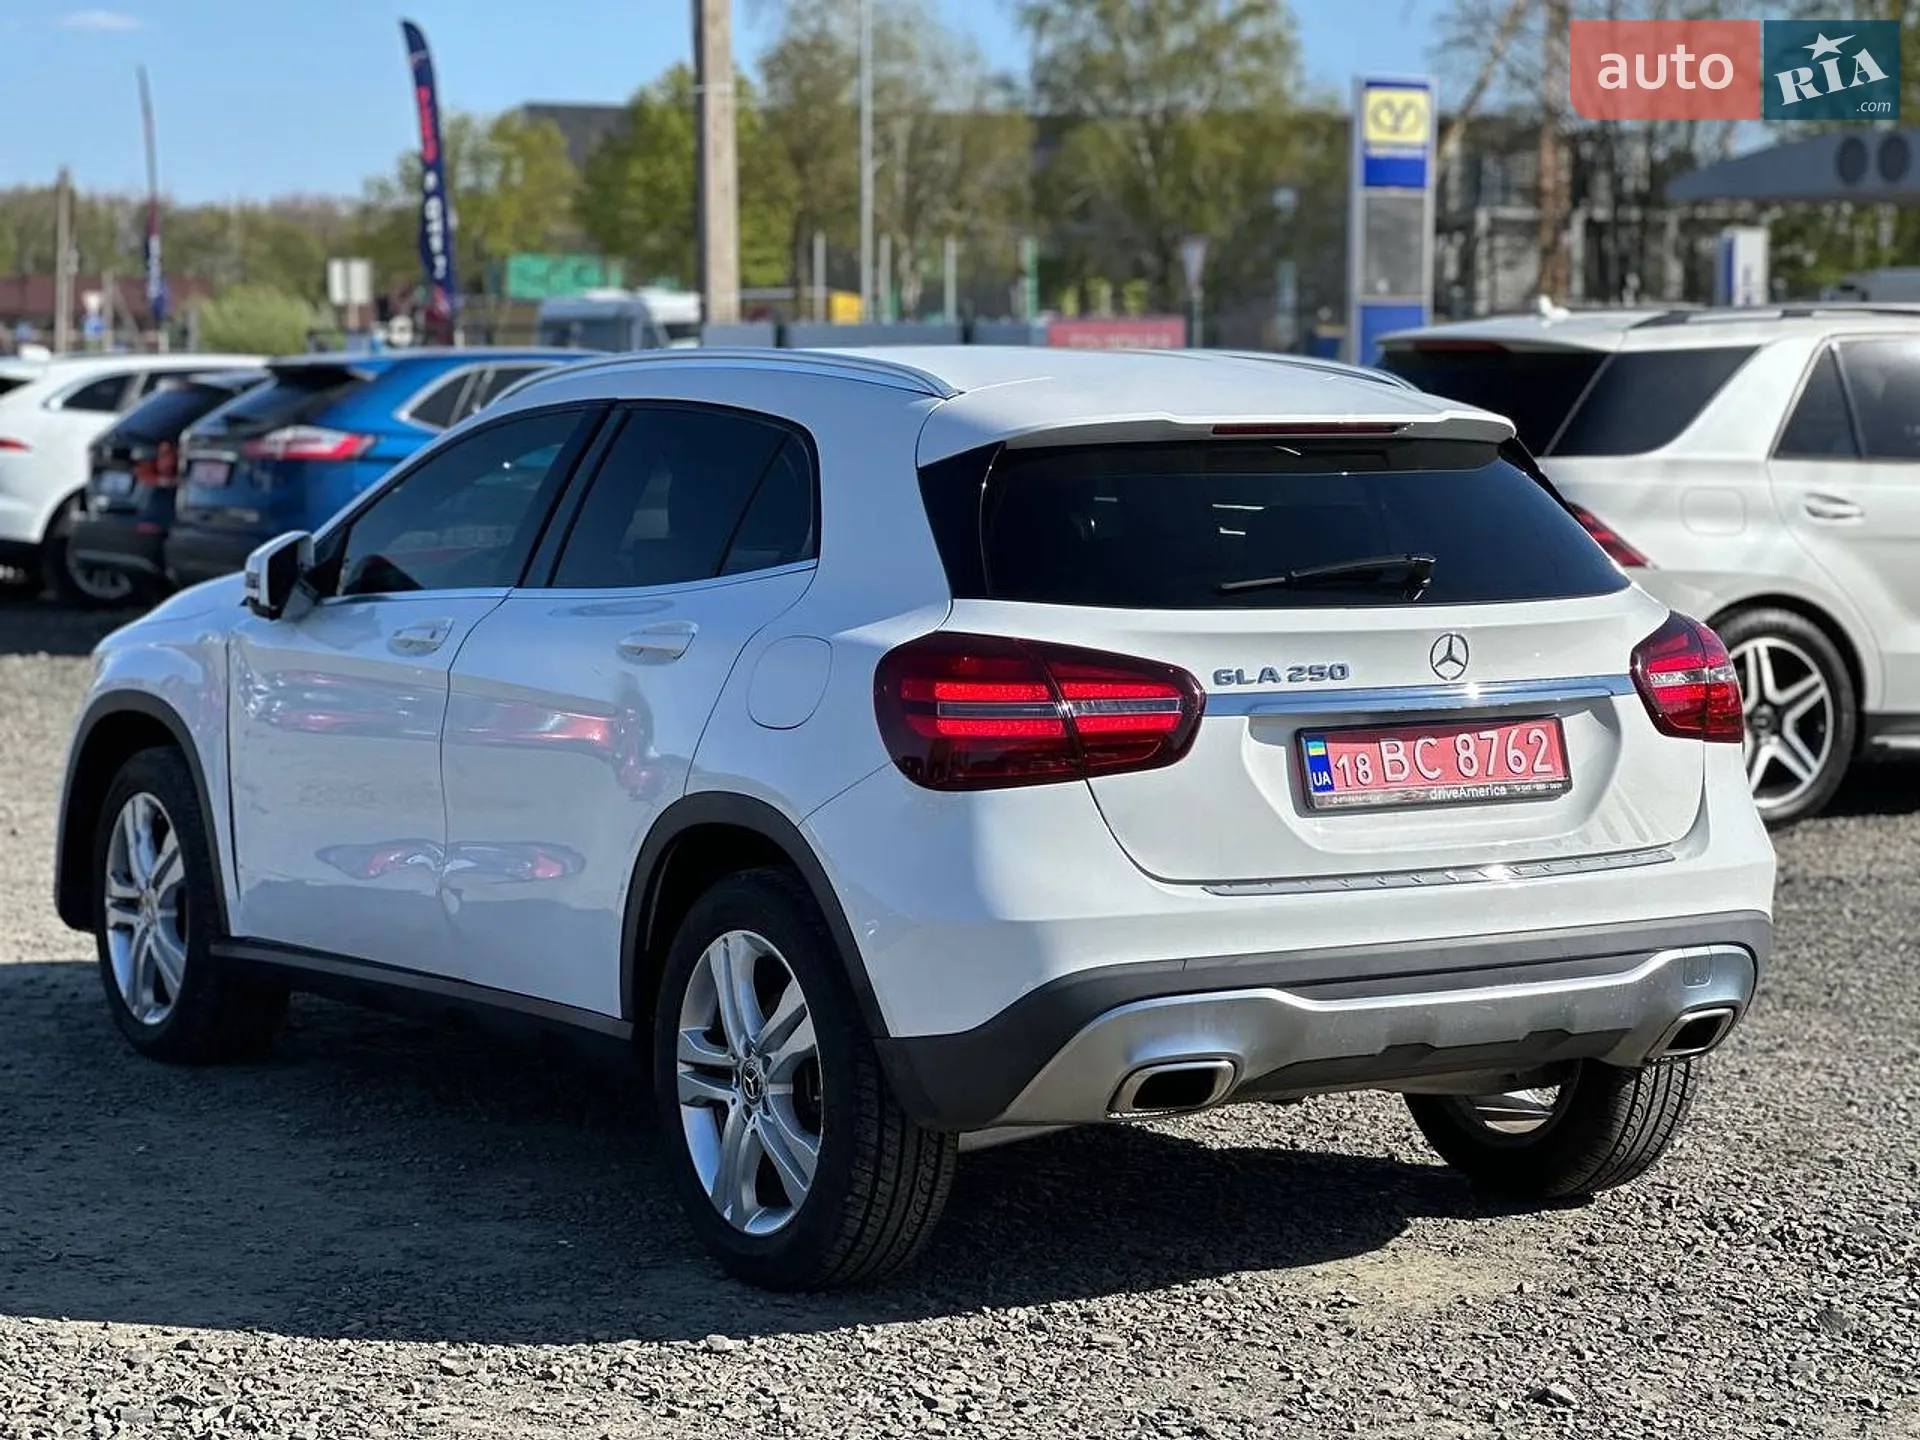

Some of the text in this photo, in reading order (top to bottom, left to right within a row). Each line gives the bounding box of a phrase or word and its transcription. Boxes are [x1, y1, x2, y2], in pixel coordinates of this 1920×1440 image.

[1213, 663, 1350, 686] GLA 250
[1313, 728, 1554, 788] UA 18 BC 8762
[1429, 784, 1508, 801] driveAmerica
